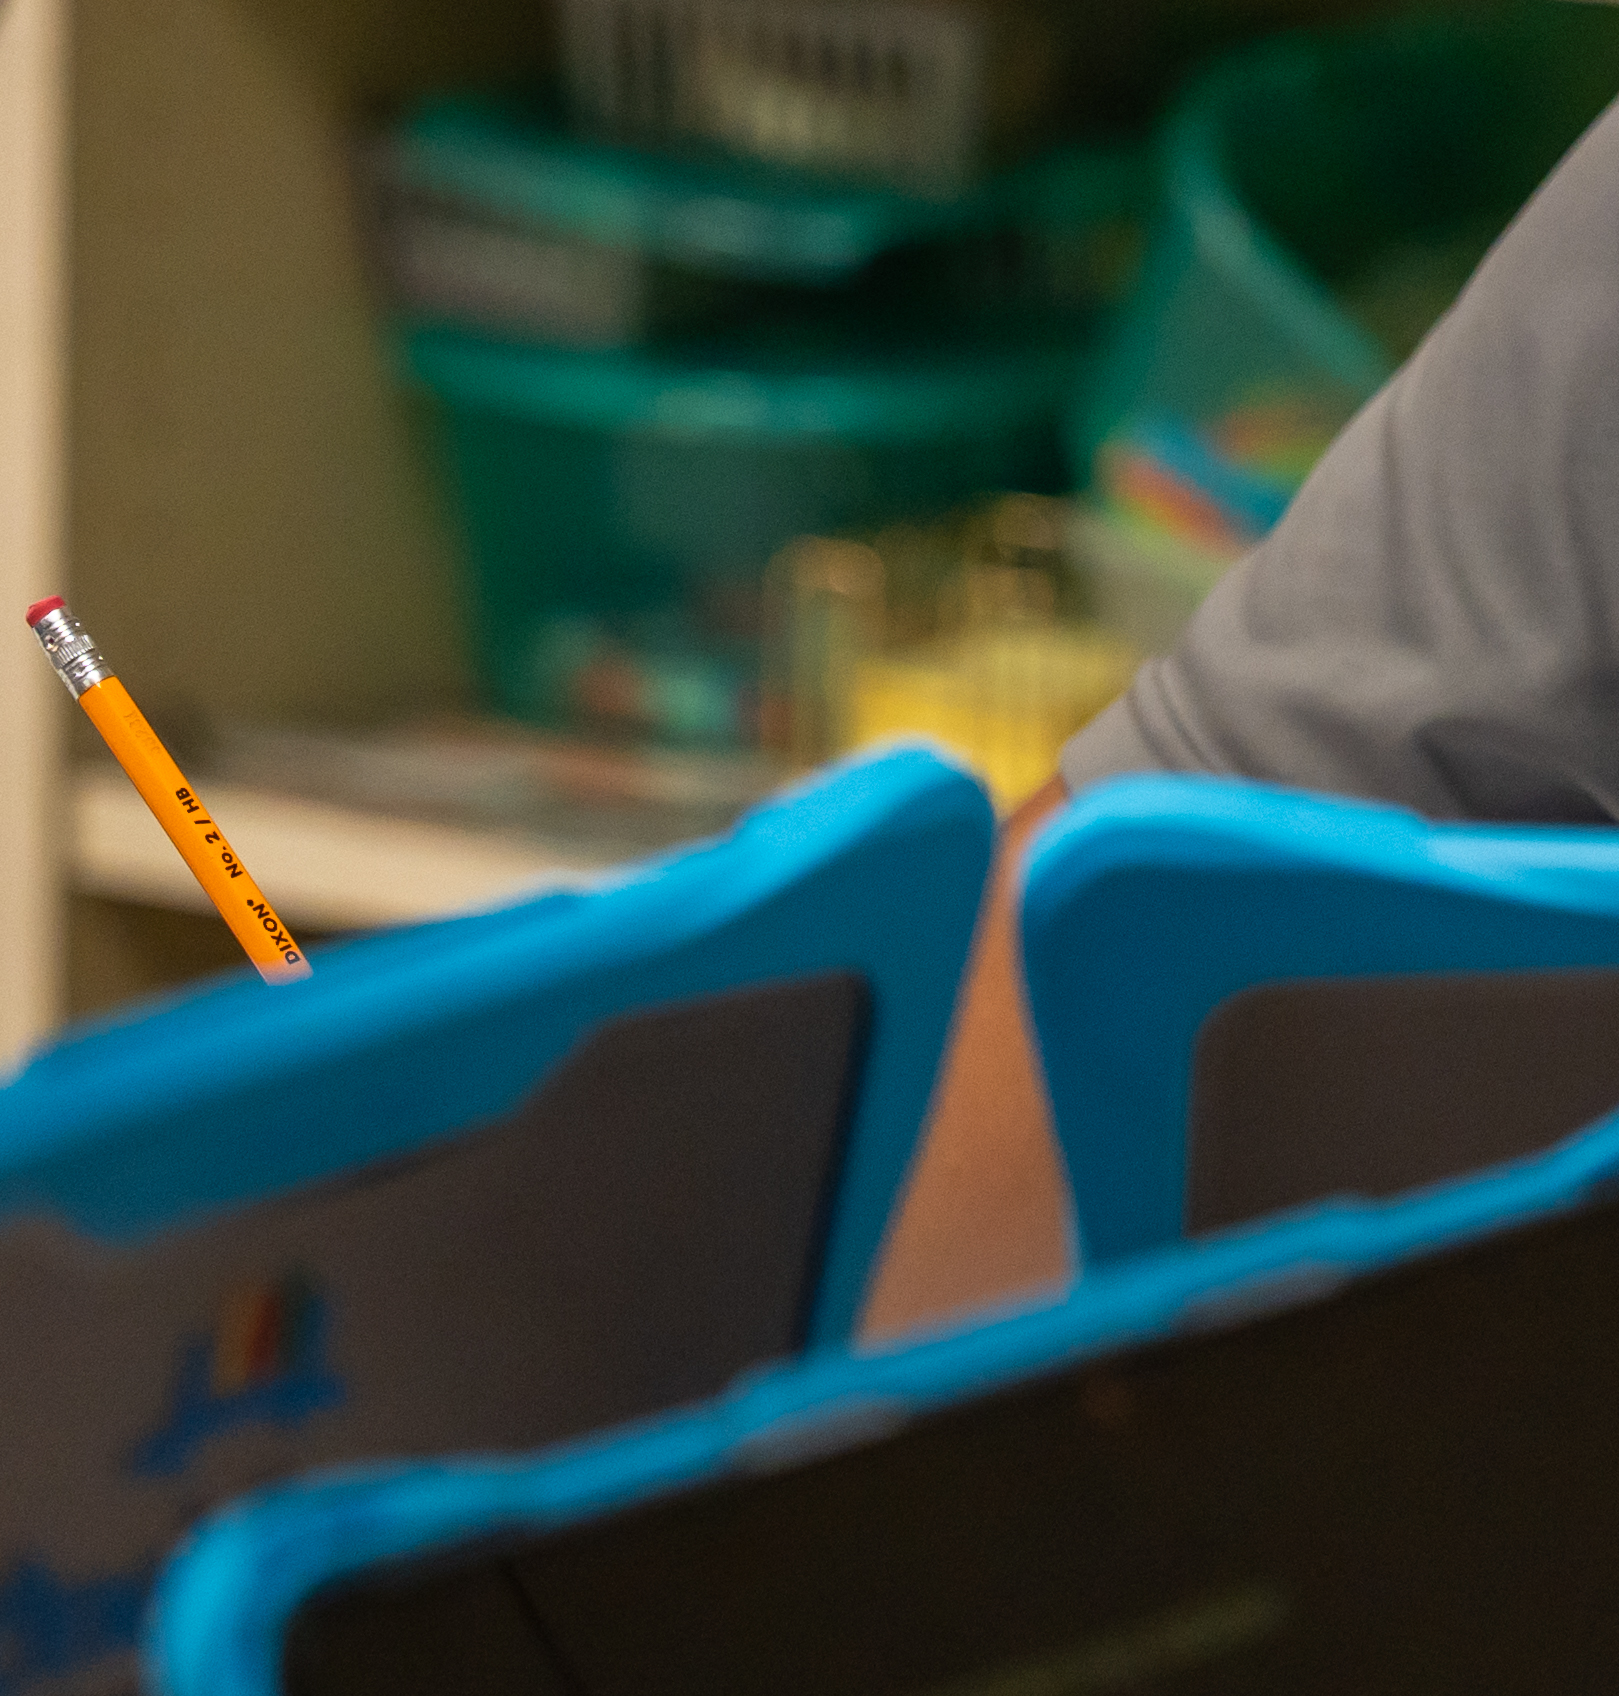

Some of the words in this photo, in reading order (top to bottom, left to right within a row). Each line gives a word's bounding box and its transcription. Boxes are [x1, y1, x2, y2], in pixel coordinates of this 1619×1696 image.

[175, 786, 200, 814] HB
[204, 831, 220, 845] 2
[222, 846, 243, 879] No.
